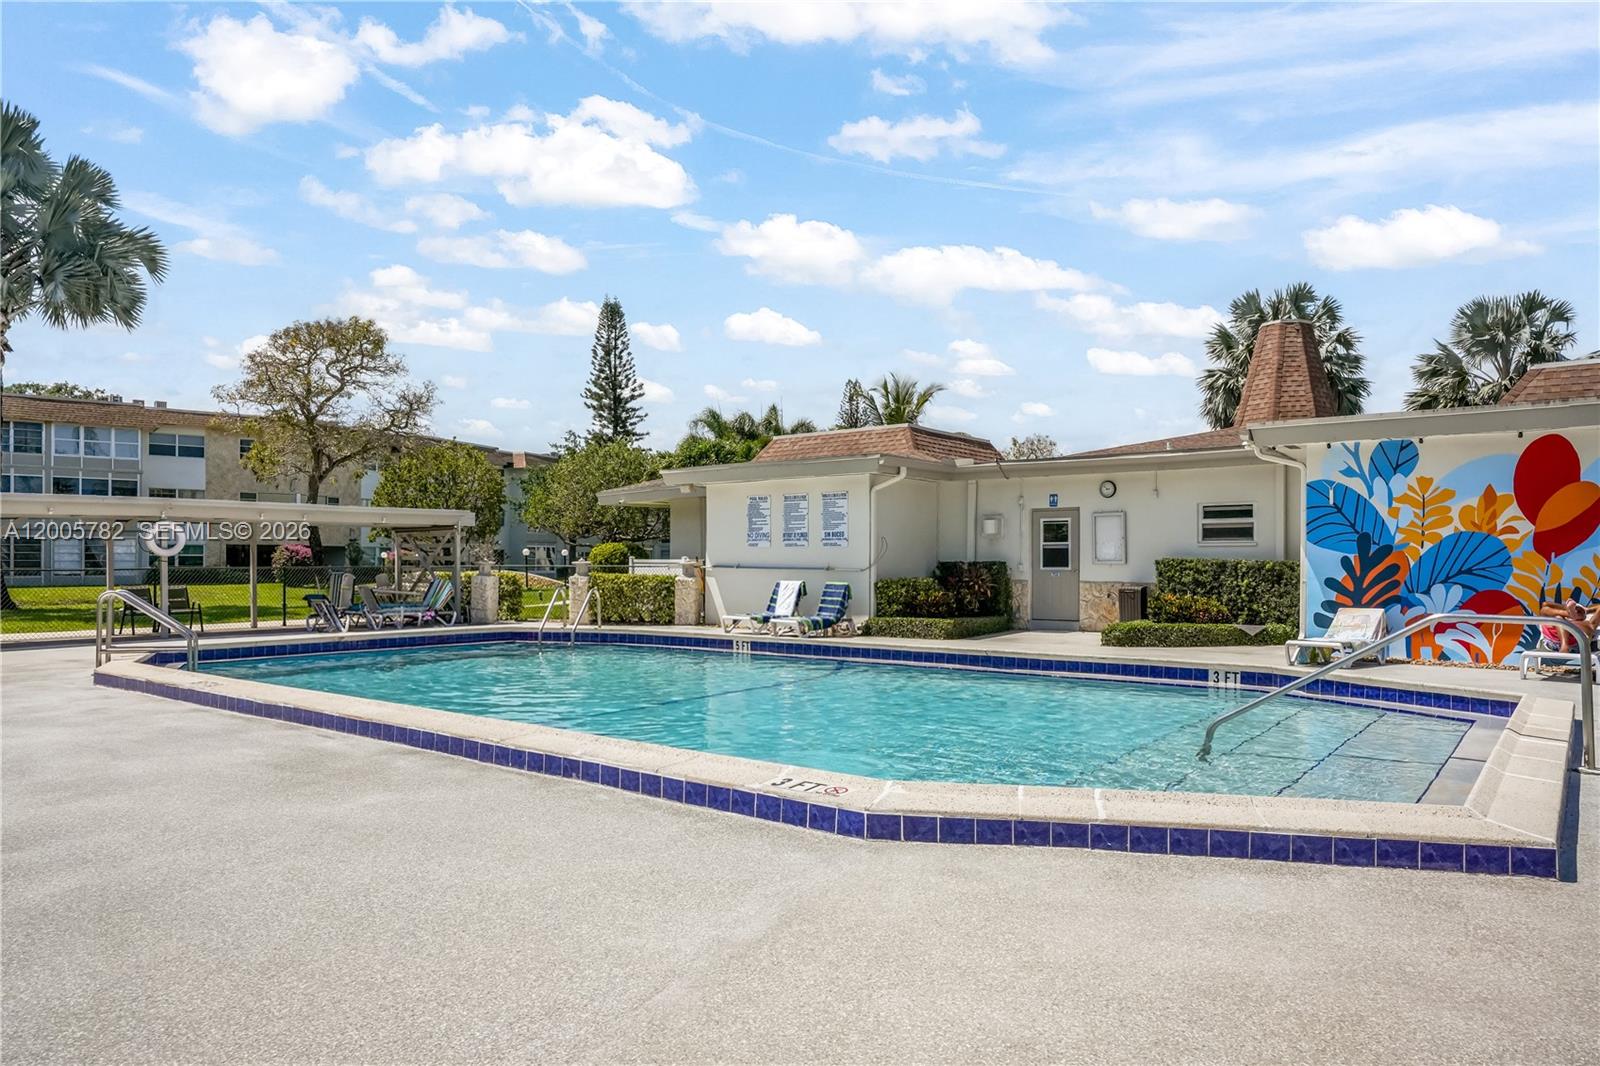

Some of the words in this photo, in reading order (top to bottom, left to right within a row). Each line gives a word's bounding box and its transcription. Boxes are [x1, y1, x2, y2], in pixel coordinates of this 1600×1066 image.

[736, 640, 739, 650] 5
[742, 640, 749, 650] FT
[1213, 671, 1219, 683] 3
[1225, 671, 1239, 684] FT
[771, 778, 793, 786] 3
[789, 781, 827, 792] FT
